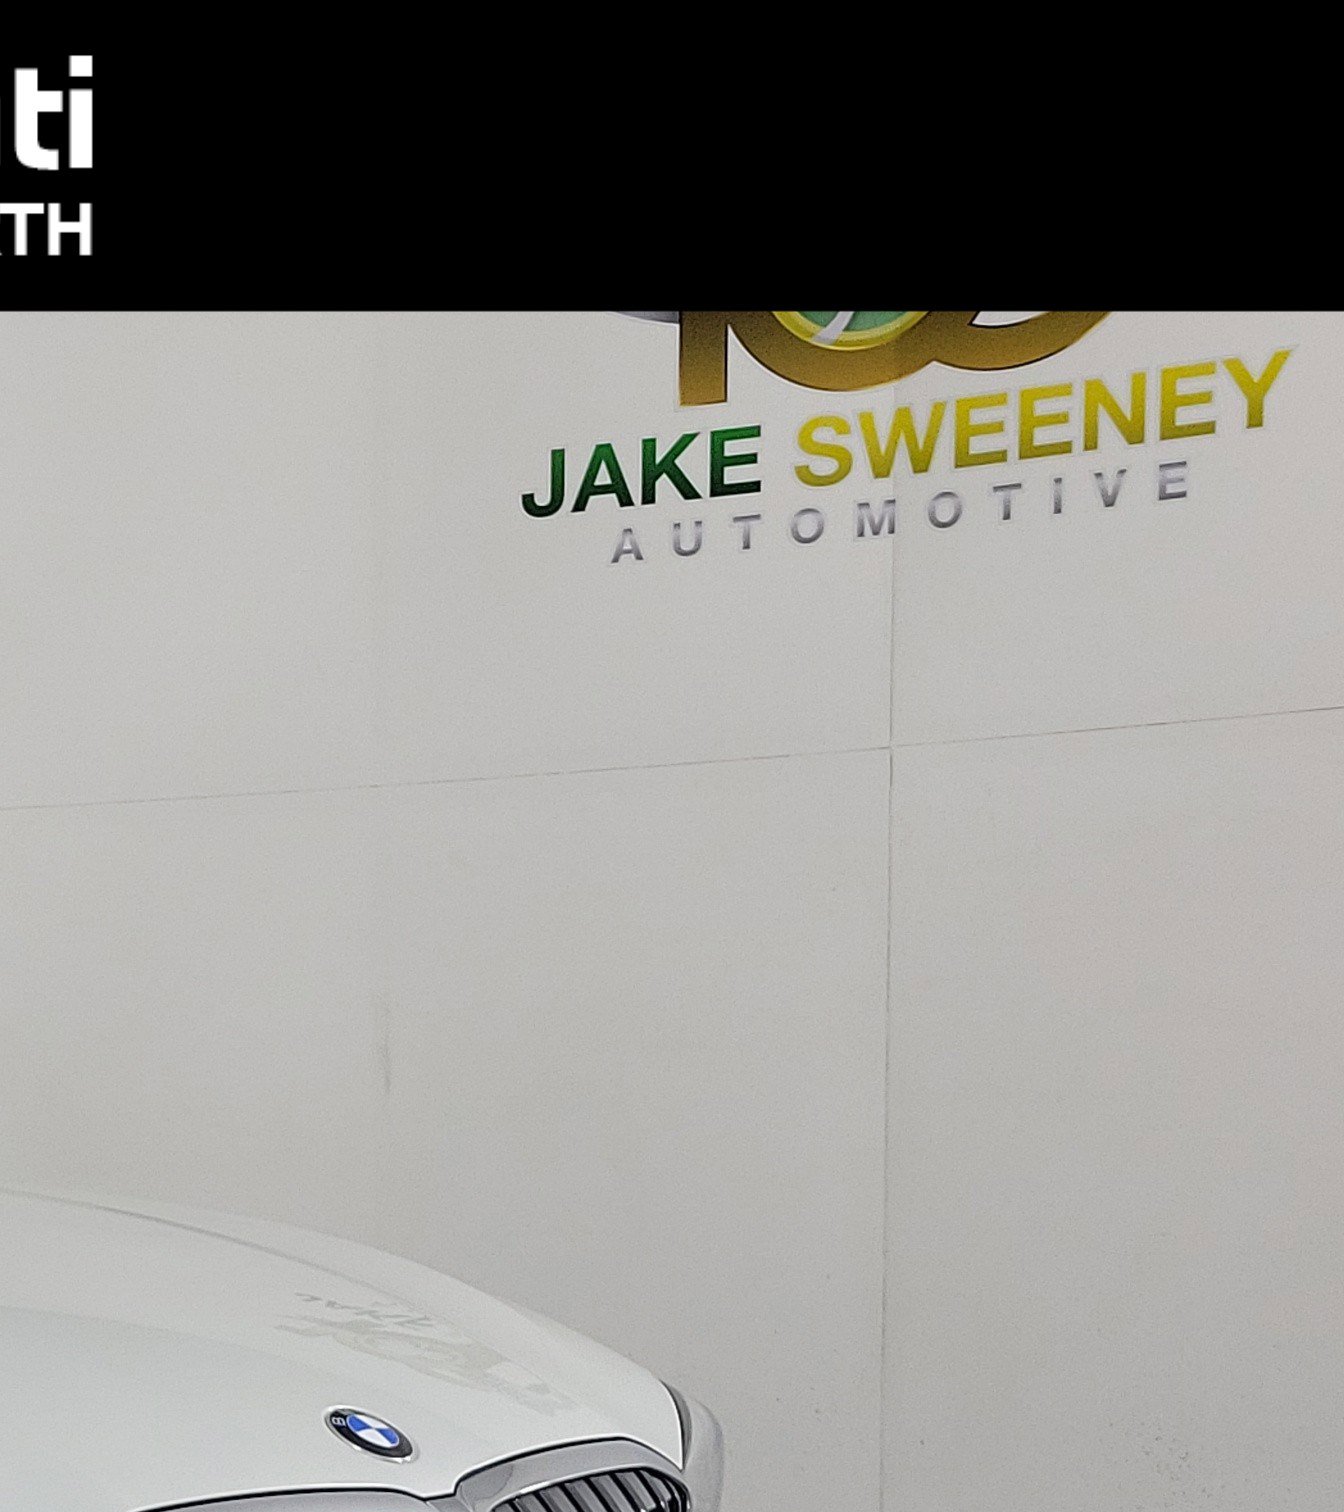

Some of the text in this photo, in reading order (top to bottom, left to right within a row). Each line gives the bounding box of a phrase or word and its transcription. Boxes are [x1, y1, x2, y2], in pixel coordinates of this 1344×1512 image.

[520, 424, 763, 518] JAKE
[794, 349, 1292, 488] SWEENEY
[611, 461, 1190, 565] AUTOMOTIVE
